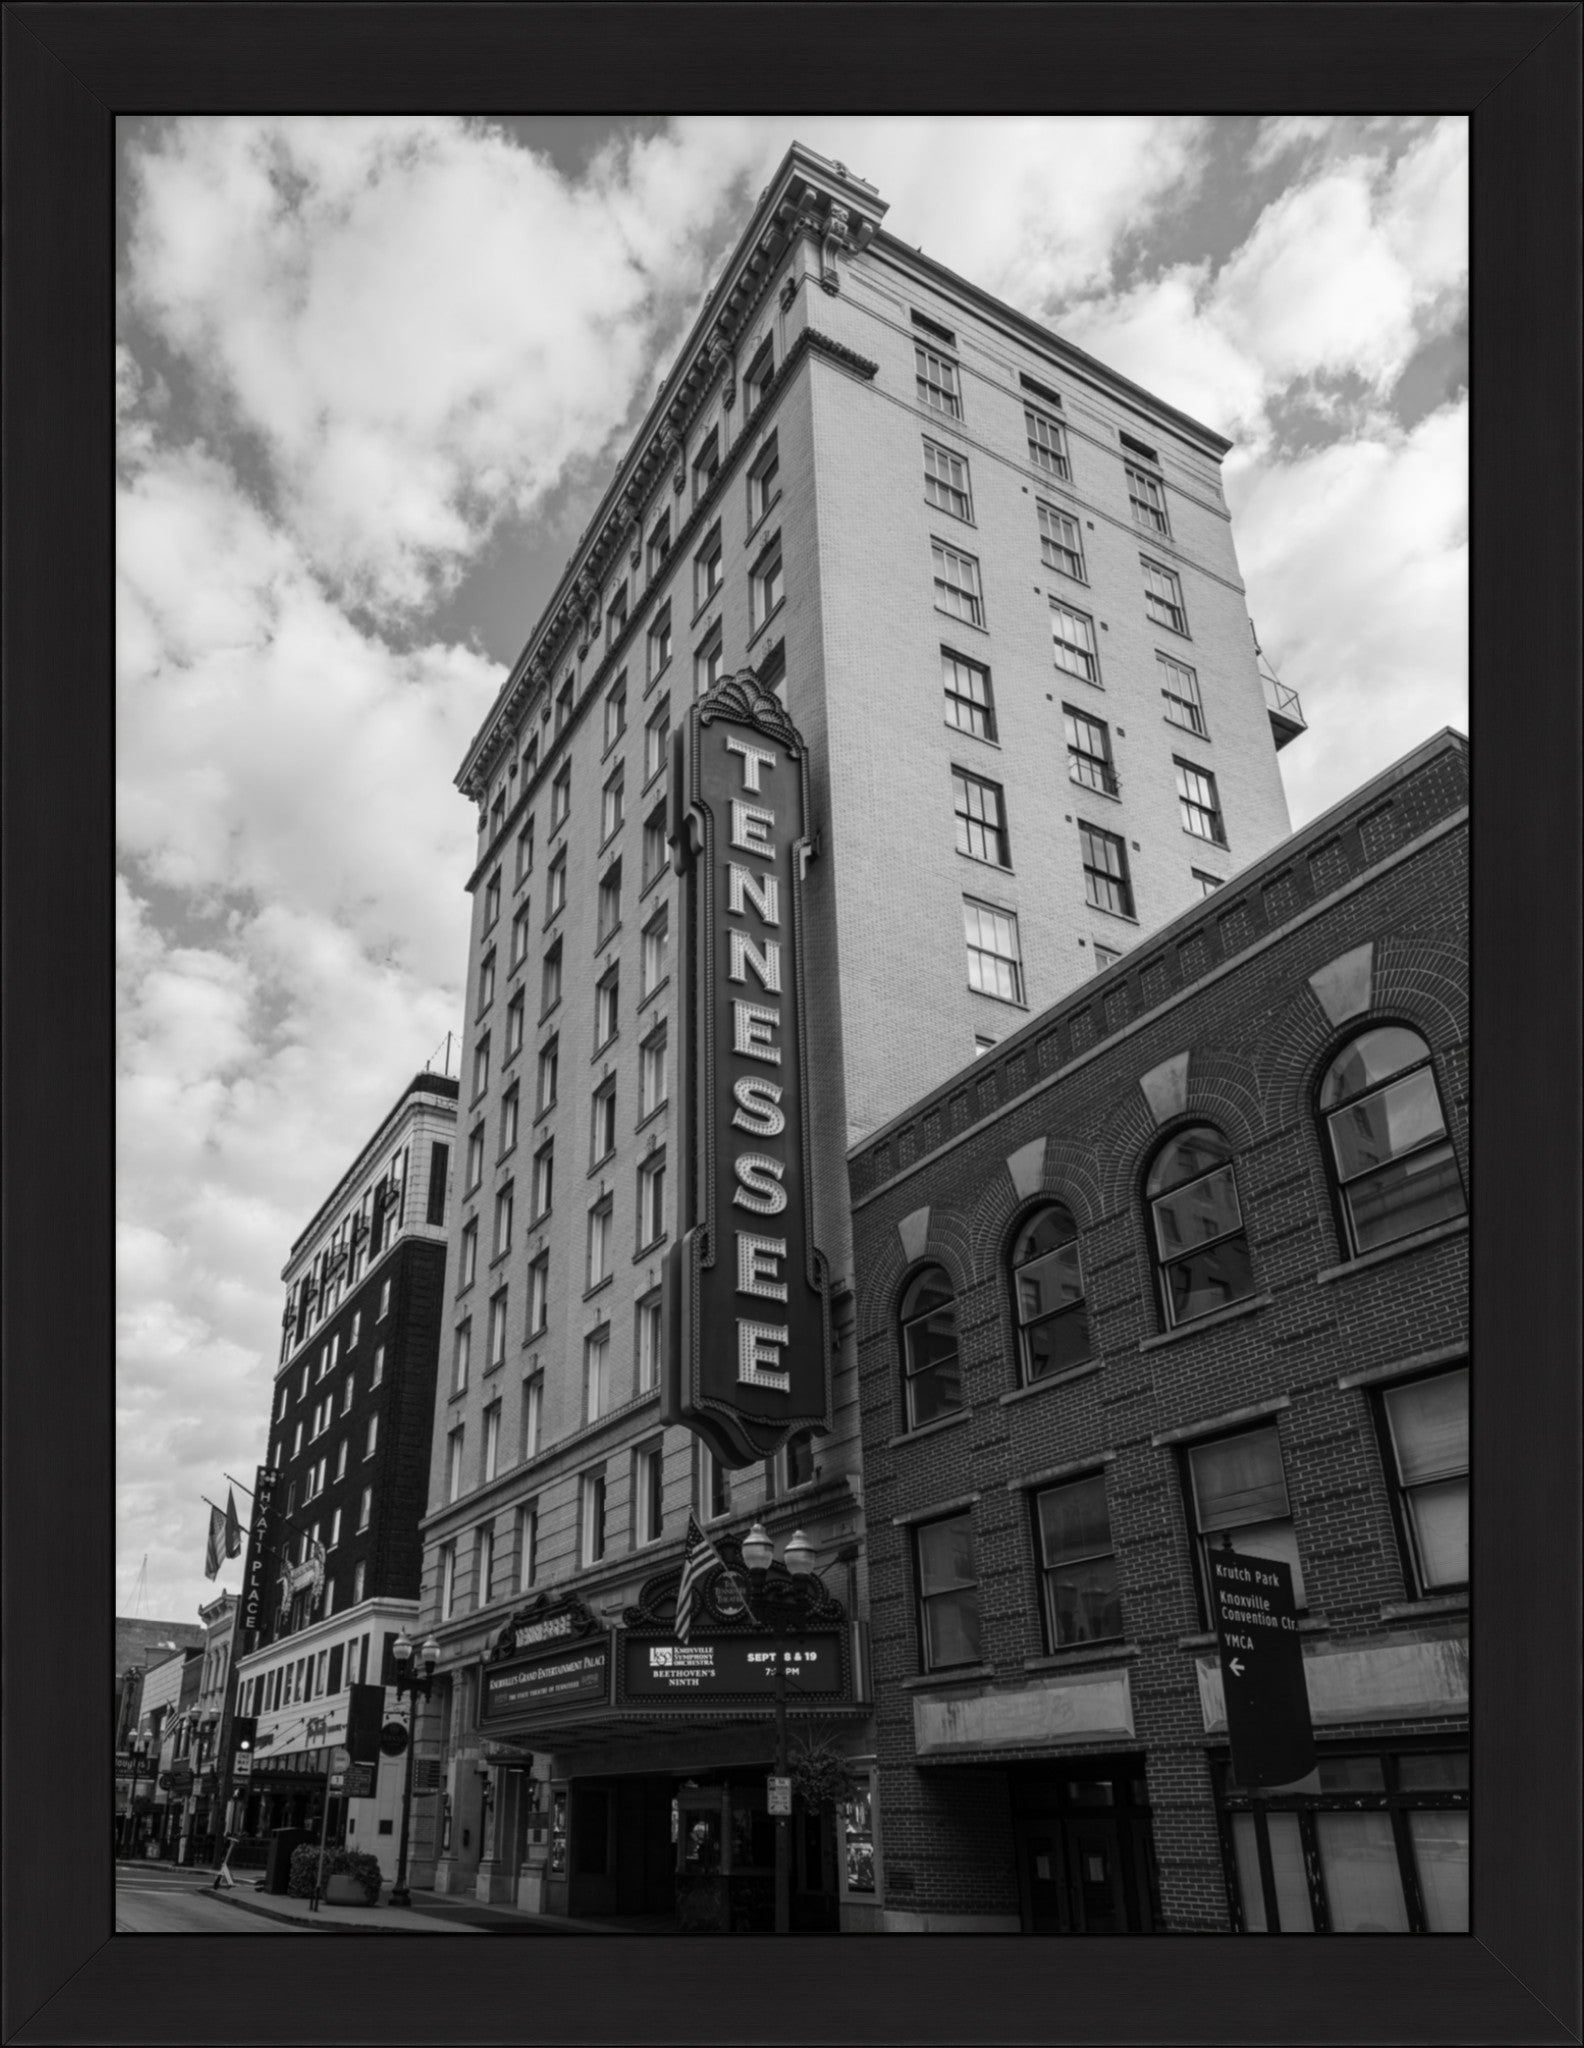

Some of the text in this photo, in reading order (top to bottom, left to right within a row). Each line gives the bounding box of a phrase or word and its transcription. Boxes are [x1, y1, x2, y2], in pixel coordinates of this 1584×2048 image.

[725, 735, 791, 1395] TENNESSEE
[245, 1491, 271, 1628] HYATT PLACE
[1216, 1563, 1280, 1587] Krutch Park
[1220, 1591, 1270, 1611] Knoxville
[1221, 1607, 1299, 1631] Convention Ctr.
[1224, 1634, 1254, 1651] YMCA
[747, 1652, 776, 1662] SEPT
[793, 1652, 802, 1662] &
[804, 1651, 817, 1661] 19
[653, 1669, 716, 1678] BEETHOVEN'S
[785, 1667, 800, 1676] PM
[669, 1678, 699, 1686] NINTH
